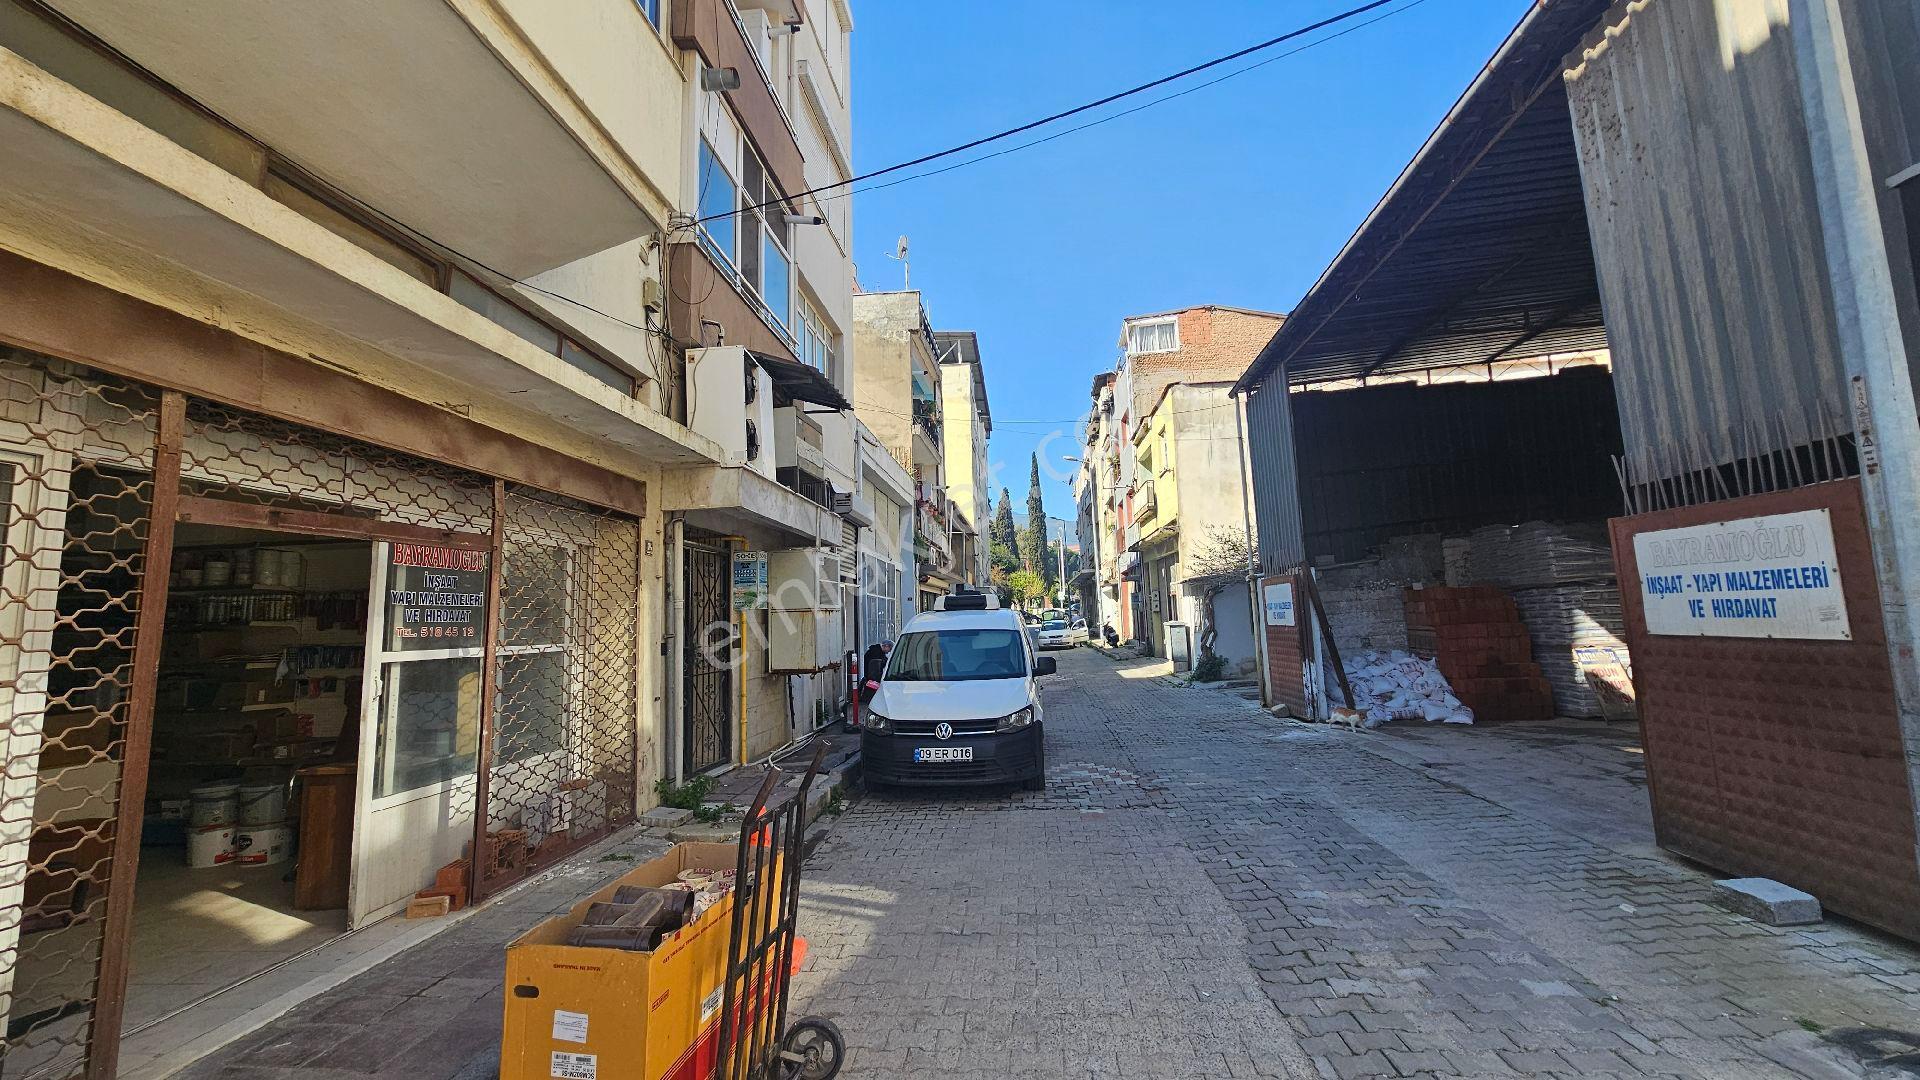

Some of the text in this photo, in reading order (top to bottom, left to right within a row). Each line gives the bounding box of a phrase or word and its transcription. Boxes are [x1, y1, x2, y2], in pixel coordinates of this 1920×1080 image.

[423, 571, 458, 591] İNŞAAT
[1646, 573, 1683, 600] İNŞAAT
[1692, 573, 1722, 593] YAPI
[1725, 560, 1830, 592] MALZEMELERİ
[391, 590, 484, 607] YAPI MALZEMELERİ
[405, 608, 472, 623] VE HIRDAVAT
[1688, 597, 1777, 619] VE HIRDAVAT
[919, 748, 972, 759] 09 ER 016
